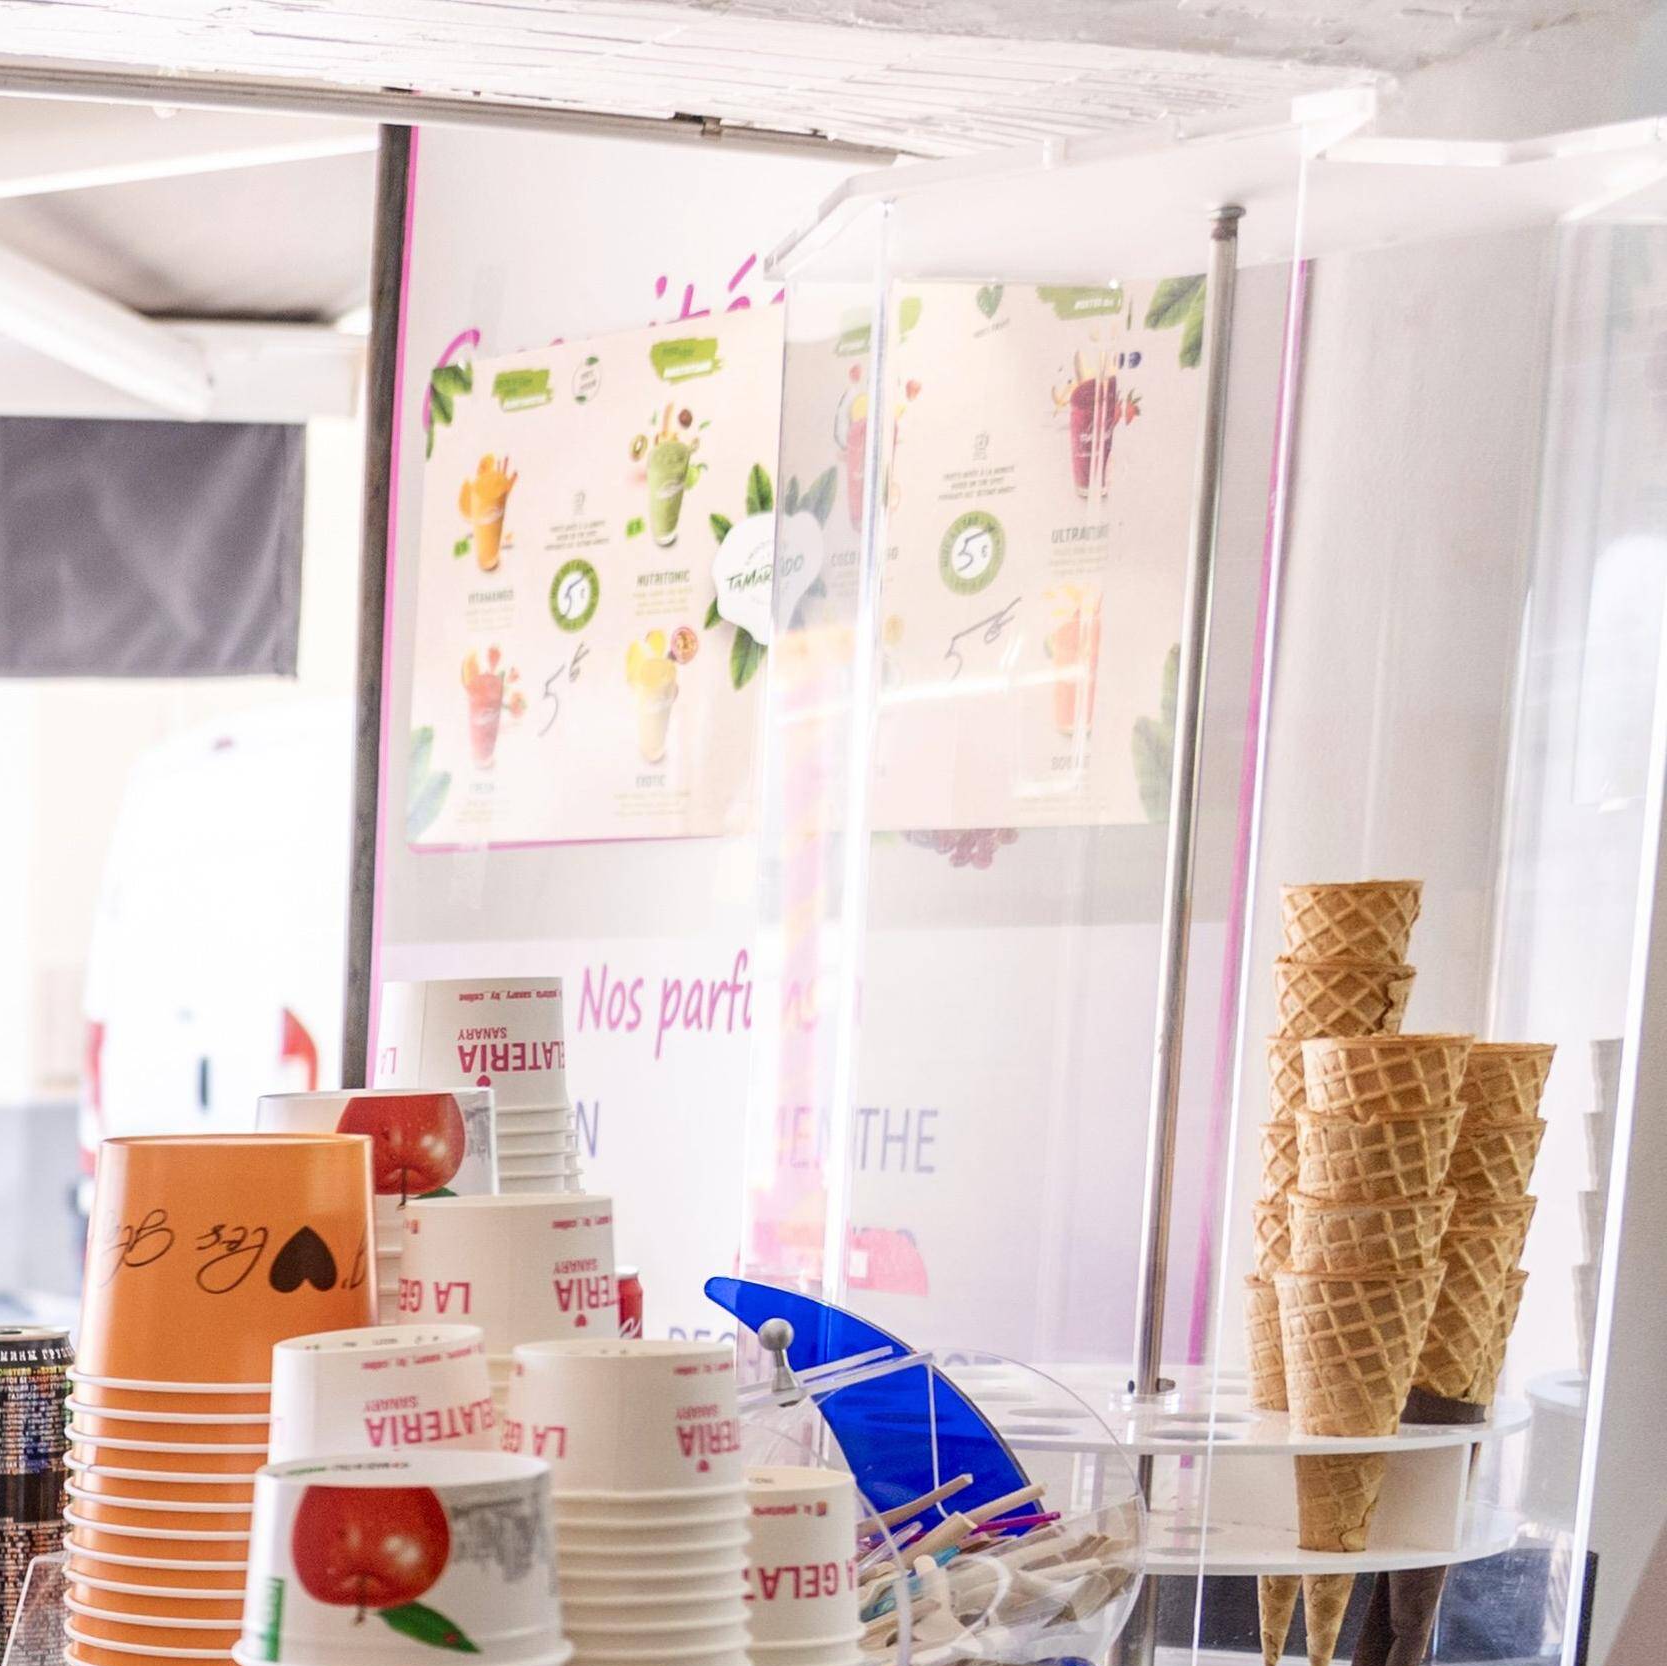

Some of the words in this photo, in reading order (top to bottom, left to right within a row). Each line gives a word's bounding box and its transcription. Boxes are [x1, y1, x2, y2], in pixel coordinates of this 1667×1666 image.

[576, 963, 645, 1033] Nos
[457, 1027, 507, 1041] SANARY
[778, 1106, 940, 1174] ENTHE
[433, 1281, 471, 1315] LA
[531, 1423, 567, 1459] LA
